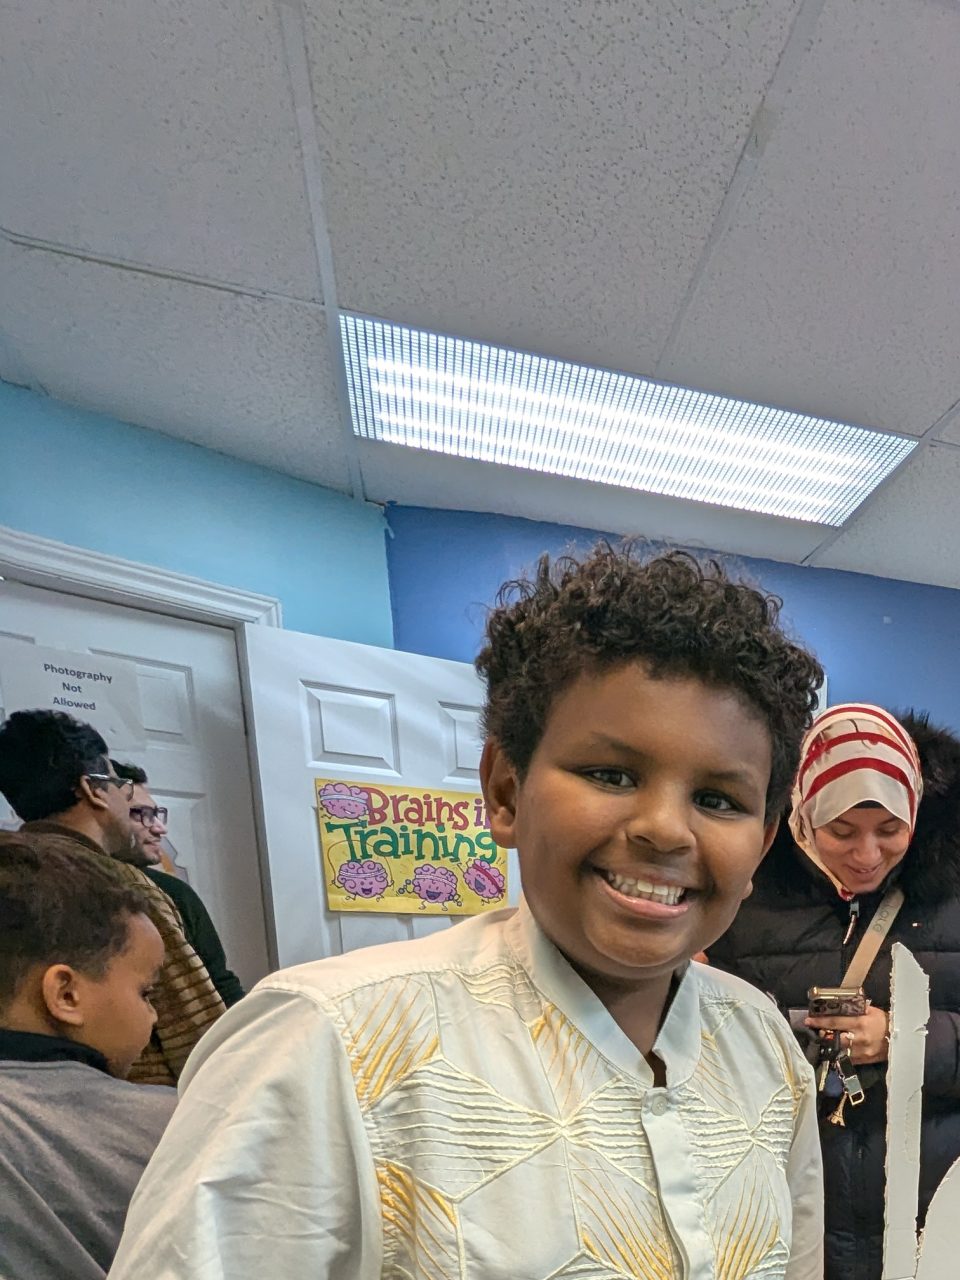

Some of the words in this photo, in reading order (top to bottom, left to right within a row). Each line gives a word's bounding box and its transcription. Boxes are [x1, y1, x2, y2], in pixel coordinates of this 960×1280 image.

[43, 663, 113, 684] Photography
[62, 682, 83, 693] Not
[53, 696, 96, 710] Allowed
[361, 786, 469, 831] Brains
[325, 820, 498, 865] Training
